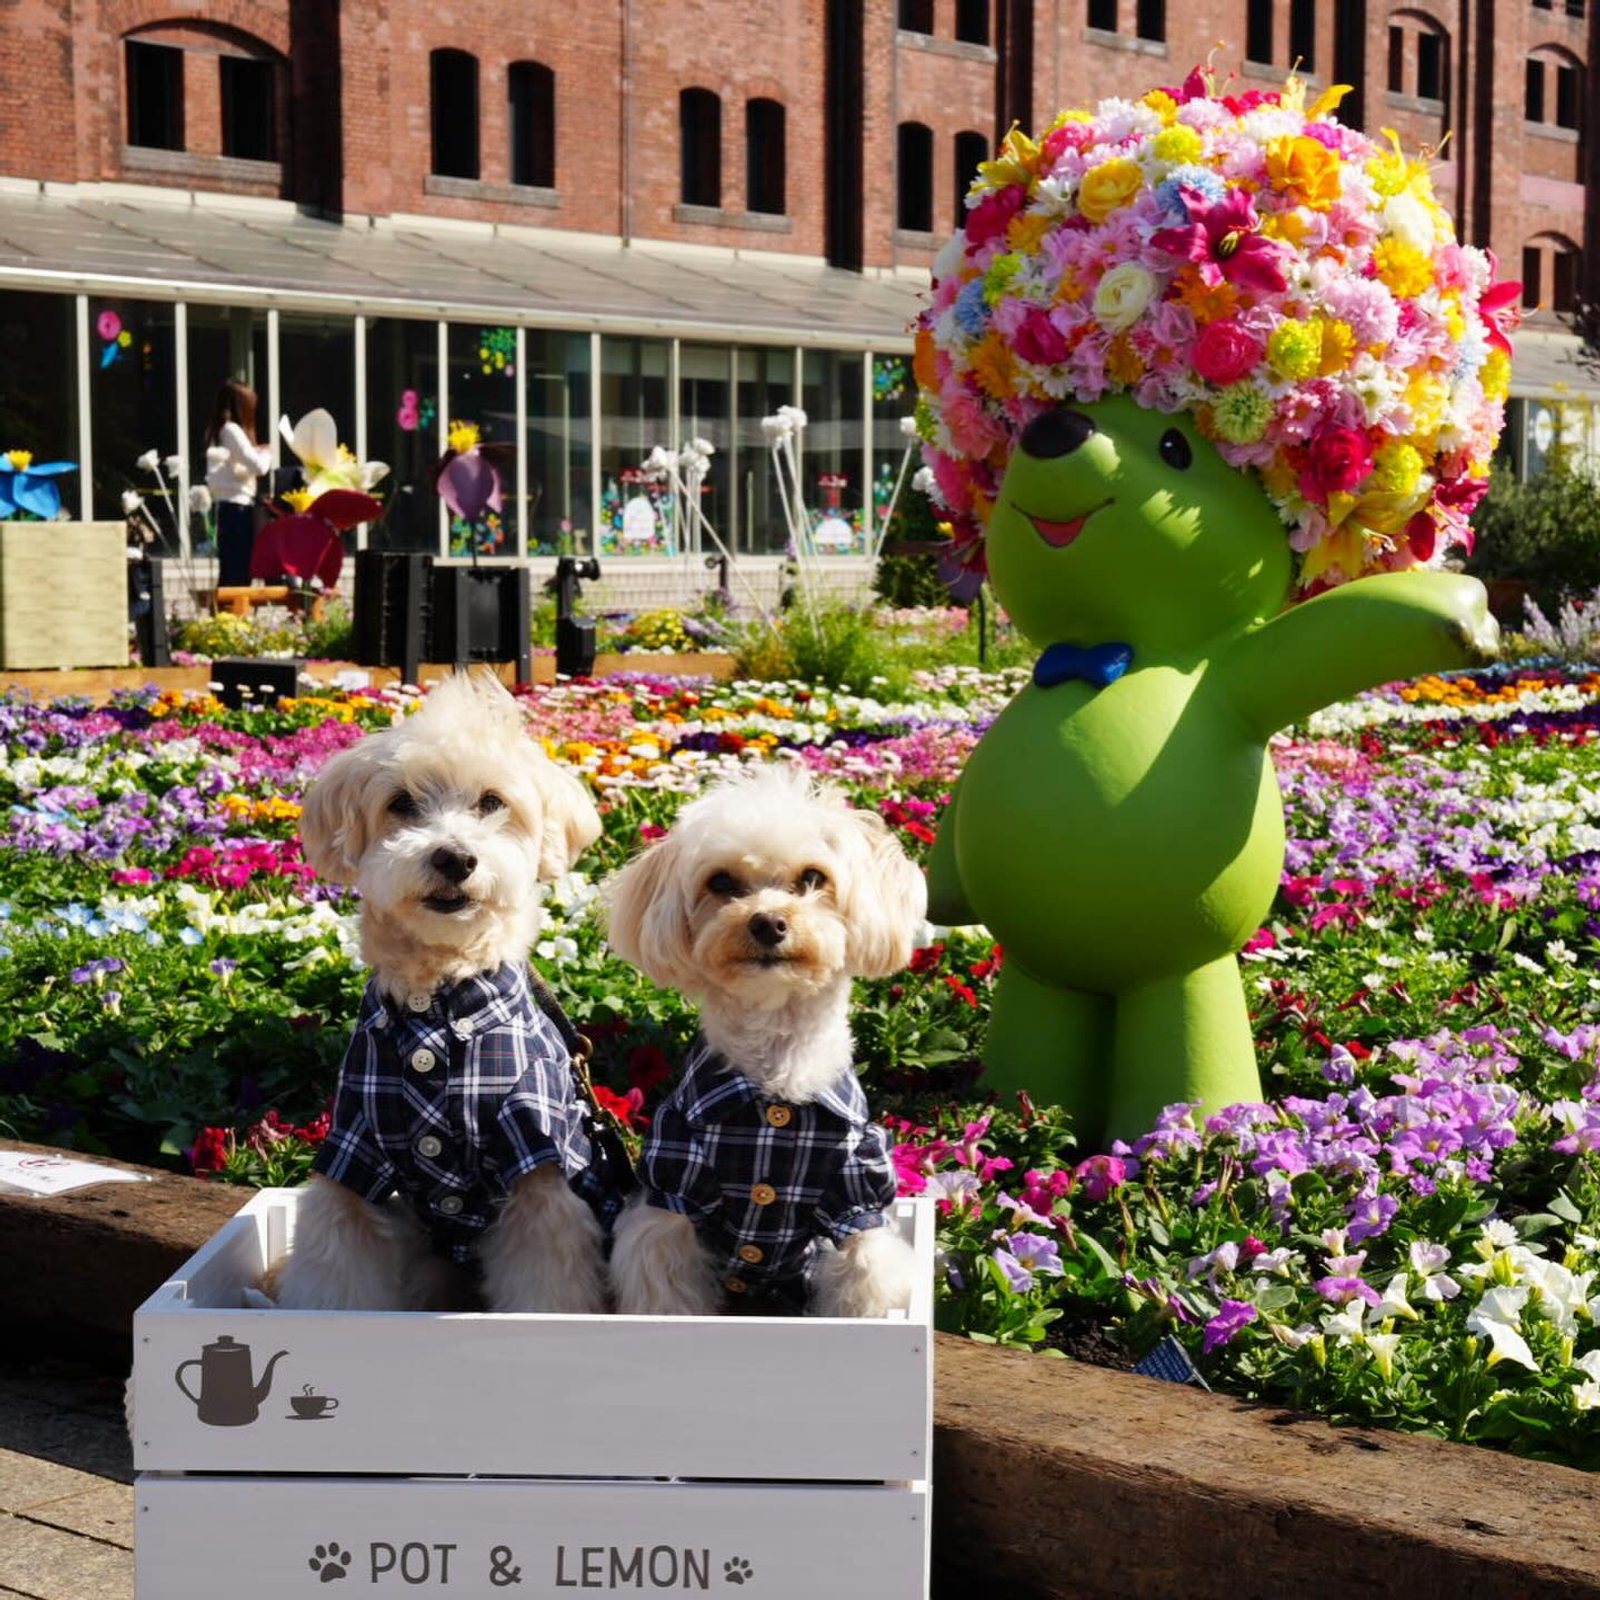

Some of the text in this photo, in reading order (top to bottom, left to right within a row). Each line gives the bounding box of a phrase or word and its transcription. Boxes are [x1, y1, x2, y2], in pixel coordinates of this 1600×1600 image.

[369, 1542, 710, 1590] POT & LEMON
